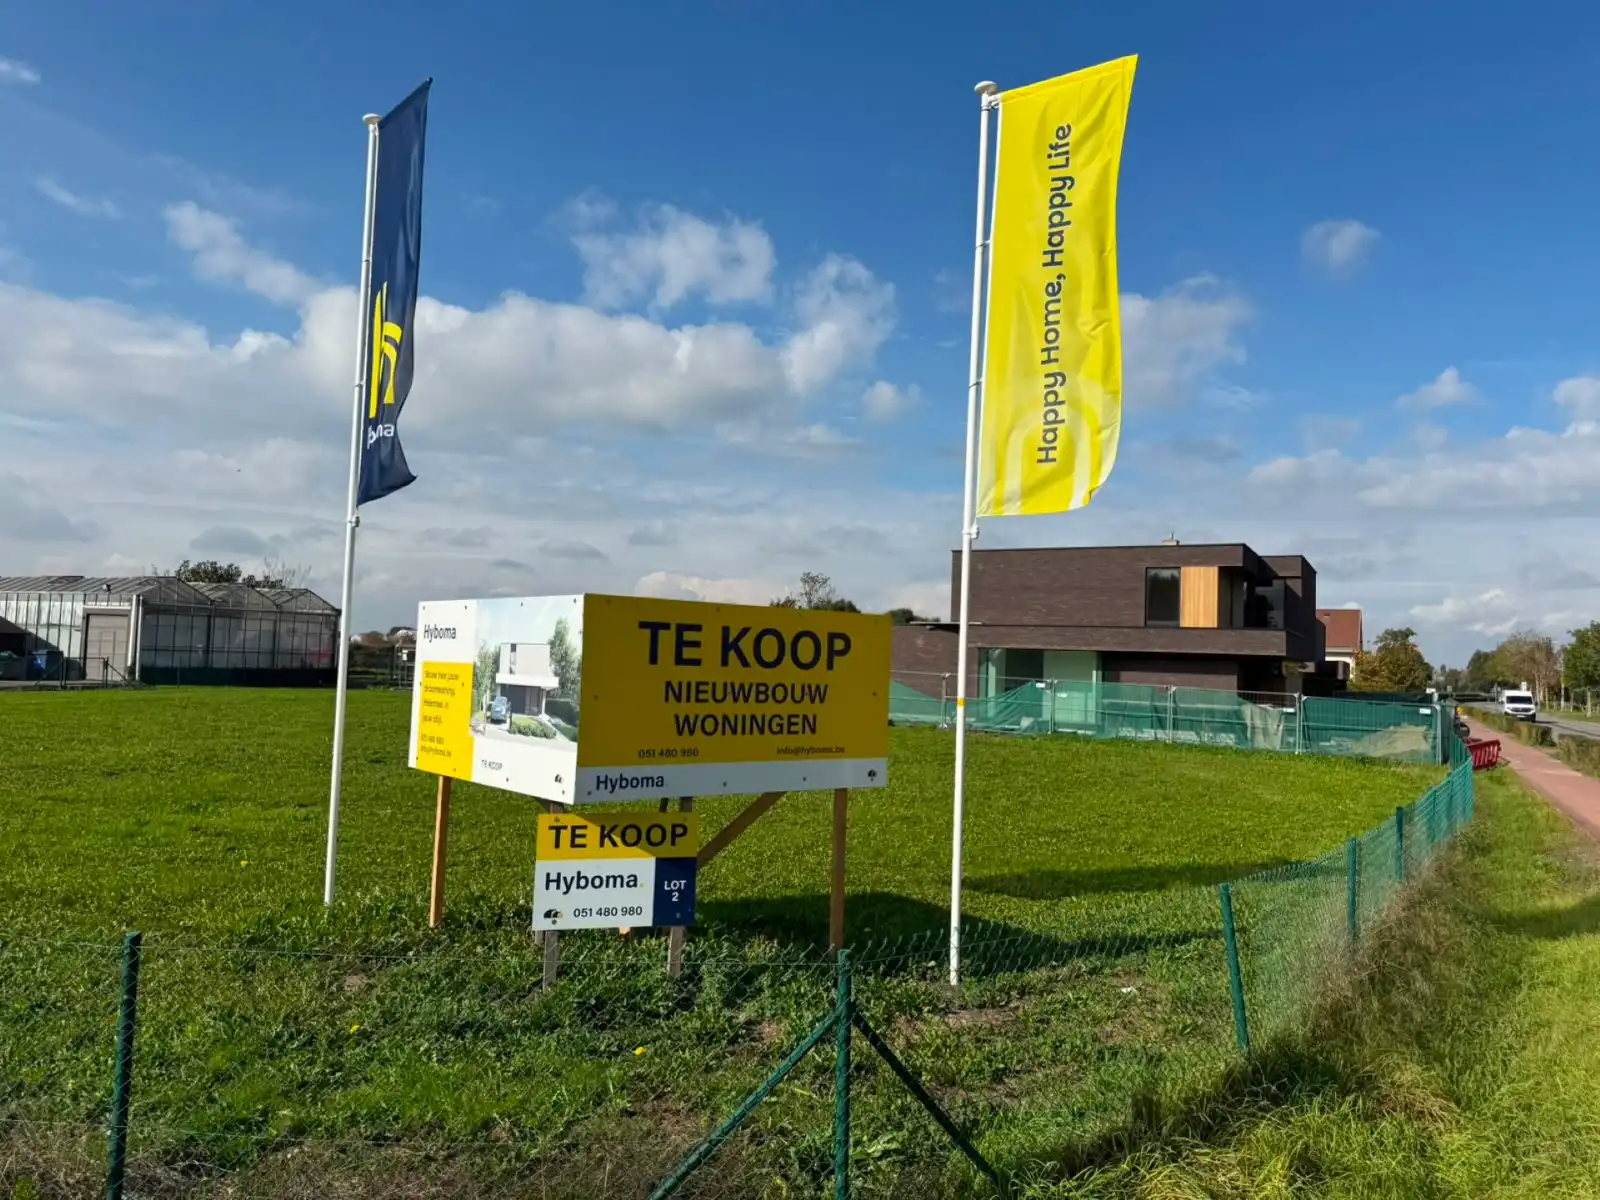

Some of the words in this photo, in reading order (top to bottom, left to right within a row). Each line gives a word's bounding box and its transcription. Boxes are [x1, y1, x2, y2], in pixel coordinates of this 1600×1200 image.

[1047, 123, 1072, 170] Life
[1042, 175, 1076, 268] Happy
[1040, 273, 1067, 365] Home,
[1036, 371, 1066, 464] Happy
[423, 623, 457, 643] Hyboma
[638, 620, 703, 667] TE
[720, 625, 852, 672] KOOP
[664, 680, 828, 704] NIEUWBOUW
[674, 713, 817, 736] WONINGEN
[638, 748, 656, 759] 051
[658, 747, 678, 758] 480
[680, 747, 700, 757] 980
[776, 744, 846, 757] info@hyboma.be
[548, 824, 588, 849] TE
[599, 823, 688, 848] KOOP
[664, 879, 687, 891] LOT
[671, 892, 680, 902] 2
[573, 908, 593, 918] 051
[596, 907, 618, 917] 480
[618, 906, 643, 917] 980
